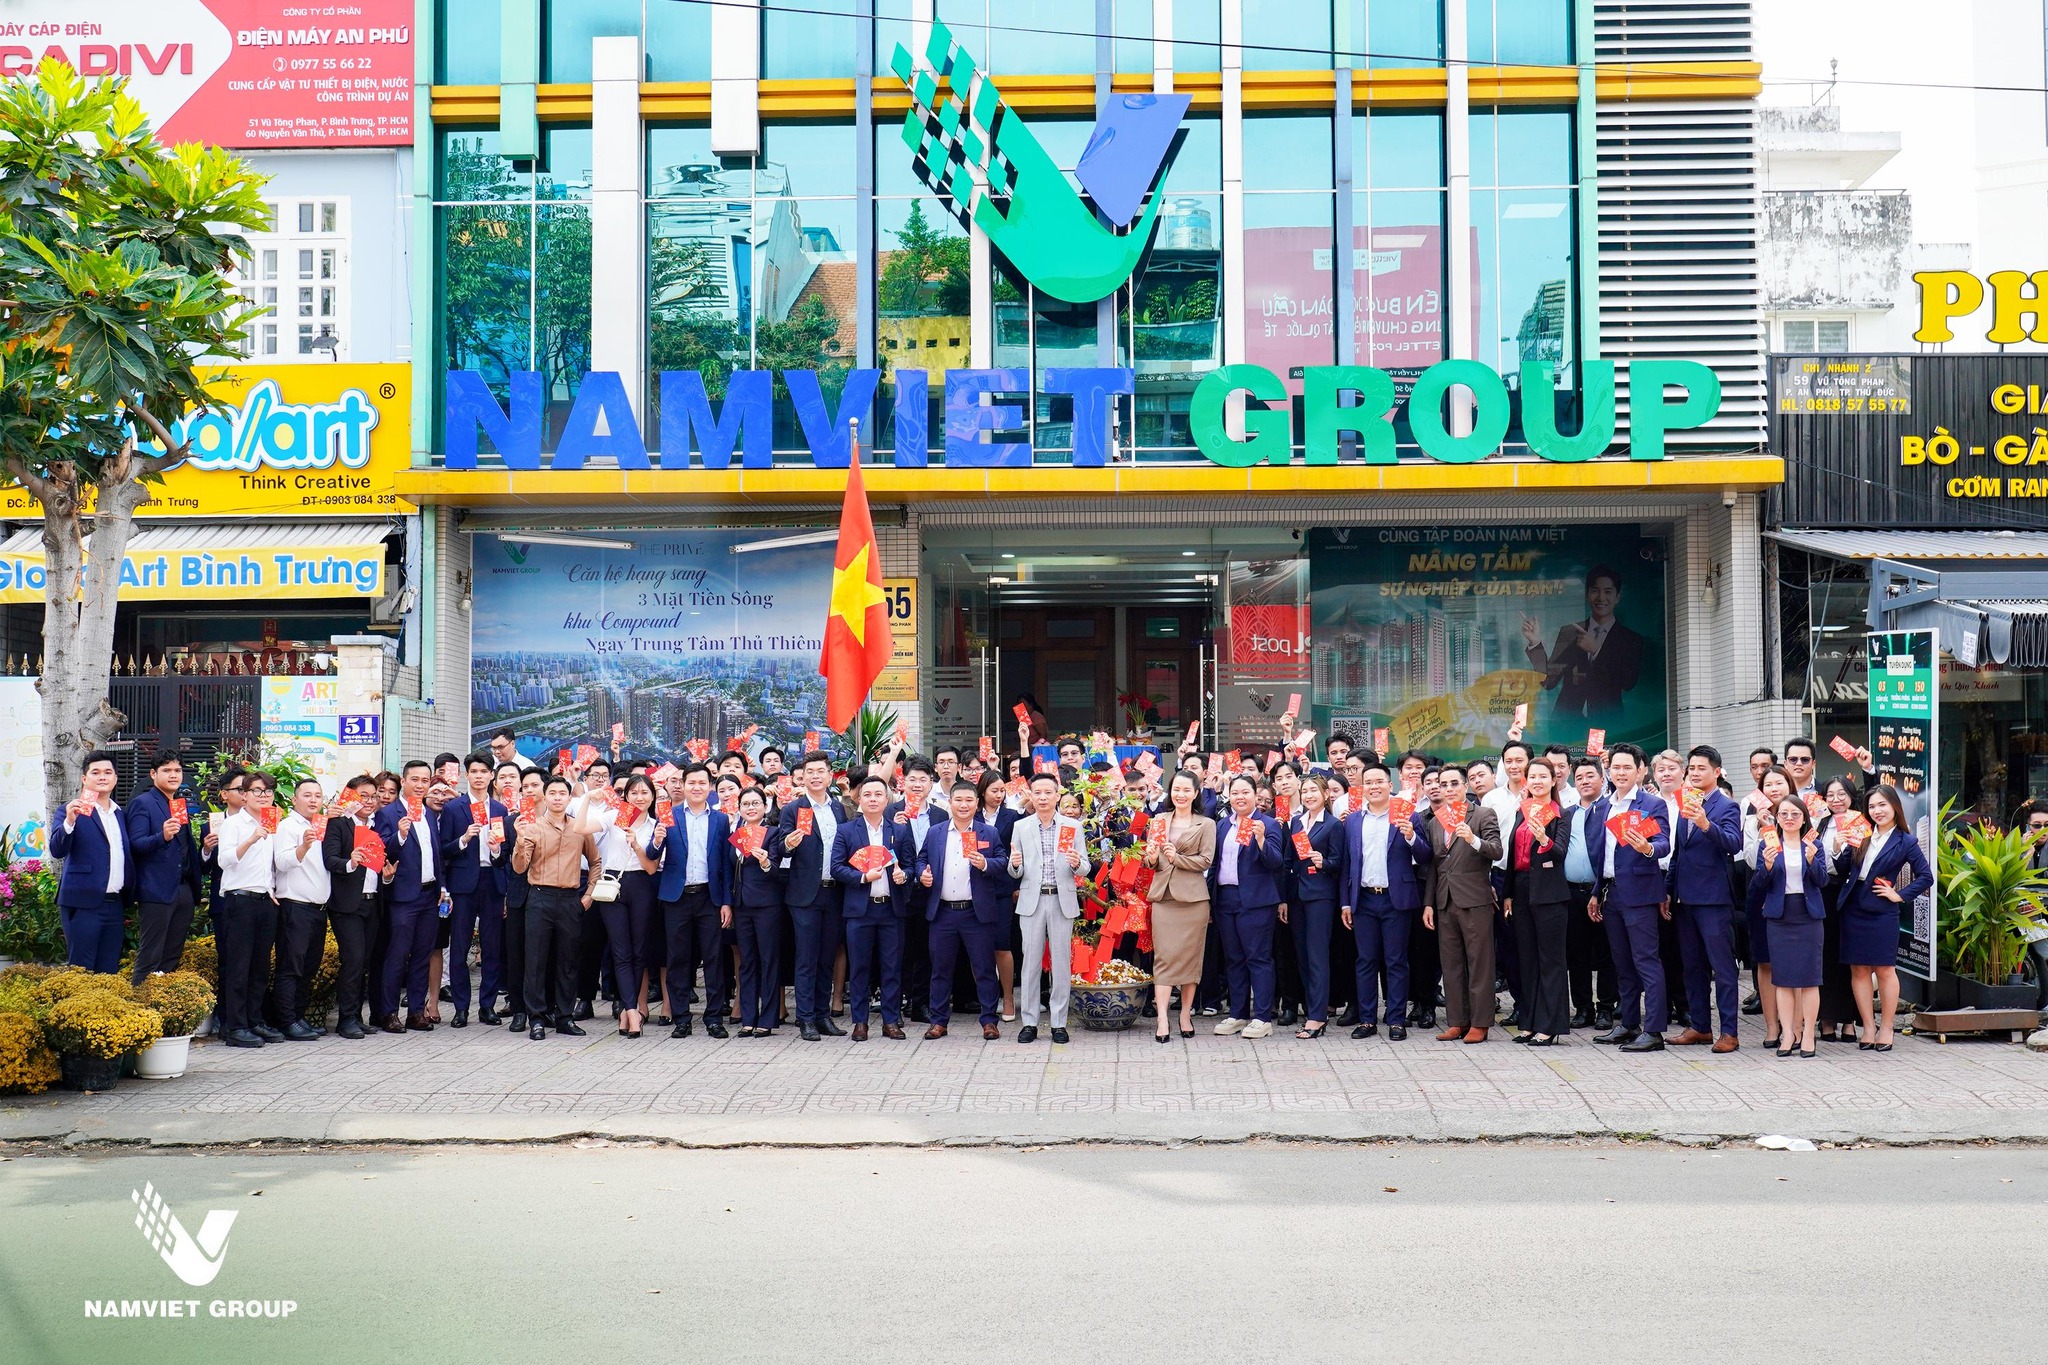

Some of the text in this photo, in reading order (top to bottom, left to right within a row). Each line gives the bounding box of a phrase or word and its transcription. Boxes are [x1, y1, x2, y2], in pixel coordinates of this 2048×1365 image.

[283, 7, 307, 16] CÔNG
[310, 8, 321, 16] TY
[29, 21, 60, 36] CÁP
[65, 21, 102, 38] ĐIỆN
[237, 25, 409, 48] ĐIỆN MÁY AN PHÚ
[291, 58, 372, 69] 0977 55 66 22
[228, 76, 408, 91] CUNG CẤP VẬT TƯ THIẾT BỊ ĐIỆN, NƯỚC
[316, 90, 408, 103] CÔNG TRÌNH DỰ ÁN
[249, 116, 408, 128] 51 Vũ Tông Phan, P. Bình Trưng, TP. HCM
[246, 129, 256, 138] 60
[258, 128, 290, 139] Nguyễn
[329, 128, 336, 136] P.
[337, 128, 351, 137] Tân
[353, 128, 375, 138] Định,
[377, 128, 388, 136] TP.
[390, 127, 408, 136] HCM
[1803, 361, 1871, 373] CHI NHÁNH 2
[1794, 376, 1884, 386] 59 VŨ TÔNG PHAN
[1816, 387, 1835, 397] PHÚ,
[1855, 387, 1871, 396] THỦ
[1877, 387, 1895, 396] ĐỨC
[1991, 384, 2048, 415] GI
[1781, 398, 1907, 411] HL: 0818 57 55 77
[445, 369, 1135, 469] NAMVIET
[1189, 359, 1721, 468] GROUP
[1901, 425, 1960, 466] BÒ
[1994, 427, 2048, 466] GÀ
[239, 474, 371, 489] Think Creative
[1947, 475, 2001, 498] CƠM
[7, 498, 26, 507] ĐC:
[168, 497, 199, 508] Trưng
[325, 496, 350, 505] 0903
[354, 495, 373, 504] 084
[377, 495, 396, 504] 338
[1378, 525, 1567, 545] CÙNG TẬP ĐOÀN NAM VIỆT
[118, 557, 168, 587] Art
[181, 553, 261, 586] Bình
[274, 555, 378, 592] Trưng
[562, 562, 708, 589] Căn hộ hạng sang
[1379, 580, 1405, 599] SỰ
[1406, 577, 1471, 599] NGHIỆP
[1473, 576, 1512, 596] CỦA
[638, 588, 773, 611] 3 Mặt Tiền Sông
[563, 610, 682, 635] khu Compound
[586, 634, 822, 655] Ngay Trung Tâm Thủ Thiêm
[302, 682, 337, 699] ART
[344, 717, 374, 734] 51
